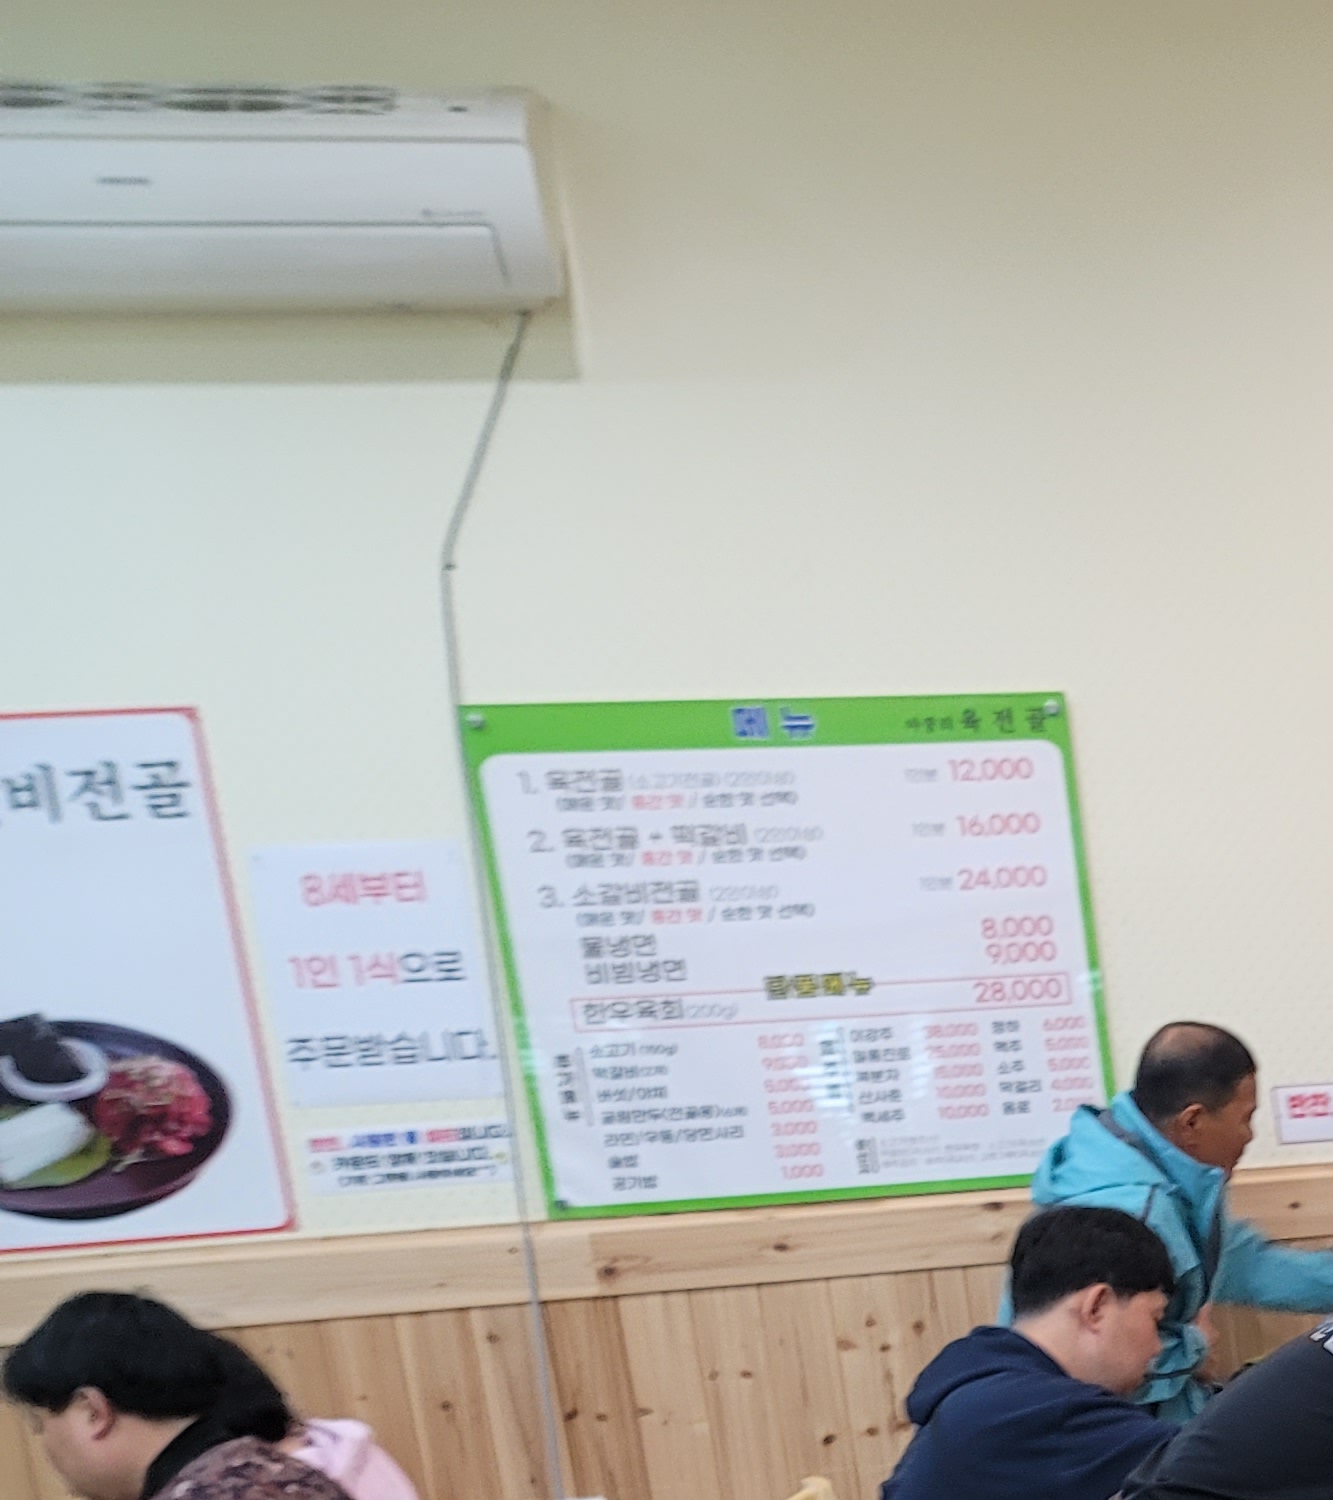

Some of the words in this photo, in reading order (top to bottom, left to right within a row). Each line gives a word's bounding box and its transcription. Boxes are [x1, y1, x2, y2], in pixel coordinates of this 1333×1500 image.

[544, 768, 622, 793] 육전골
[948, 757, 1033, 782] 12,000
[0, 760, 192, 824] 비전골
[561, 826, 638, 850] 육전골
[669, 823, 748, 846] 떡갈비
[956, 812, 1041, 838] 16,000
[300, 870, 427, 907] 8세부터
[957, 866, 1048, 891] 24,000
[573, 880, 699, 907] 소갈비전골
[981, 915, 1054, 940] 8,000
[579, 934, 657, 959] 물냉면
[985, 941, 1057, 965] 9,000
[288, 953, 340, 989] 1인
[346, 948, 467, 986] 1식으로
[583, 959, 688, 985] 비빔냉면
[972, 978, 1062, 1003] 28,000
[285, 1028, 498, 1071] 주문받습니다.
[590, 1043, 636, 1059] 소고기
[781, 1164, 824, 1180] 1,000
